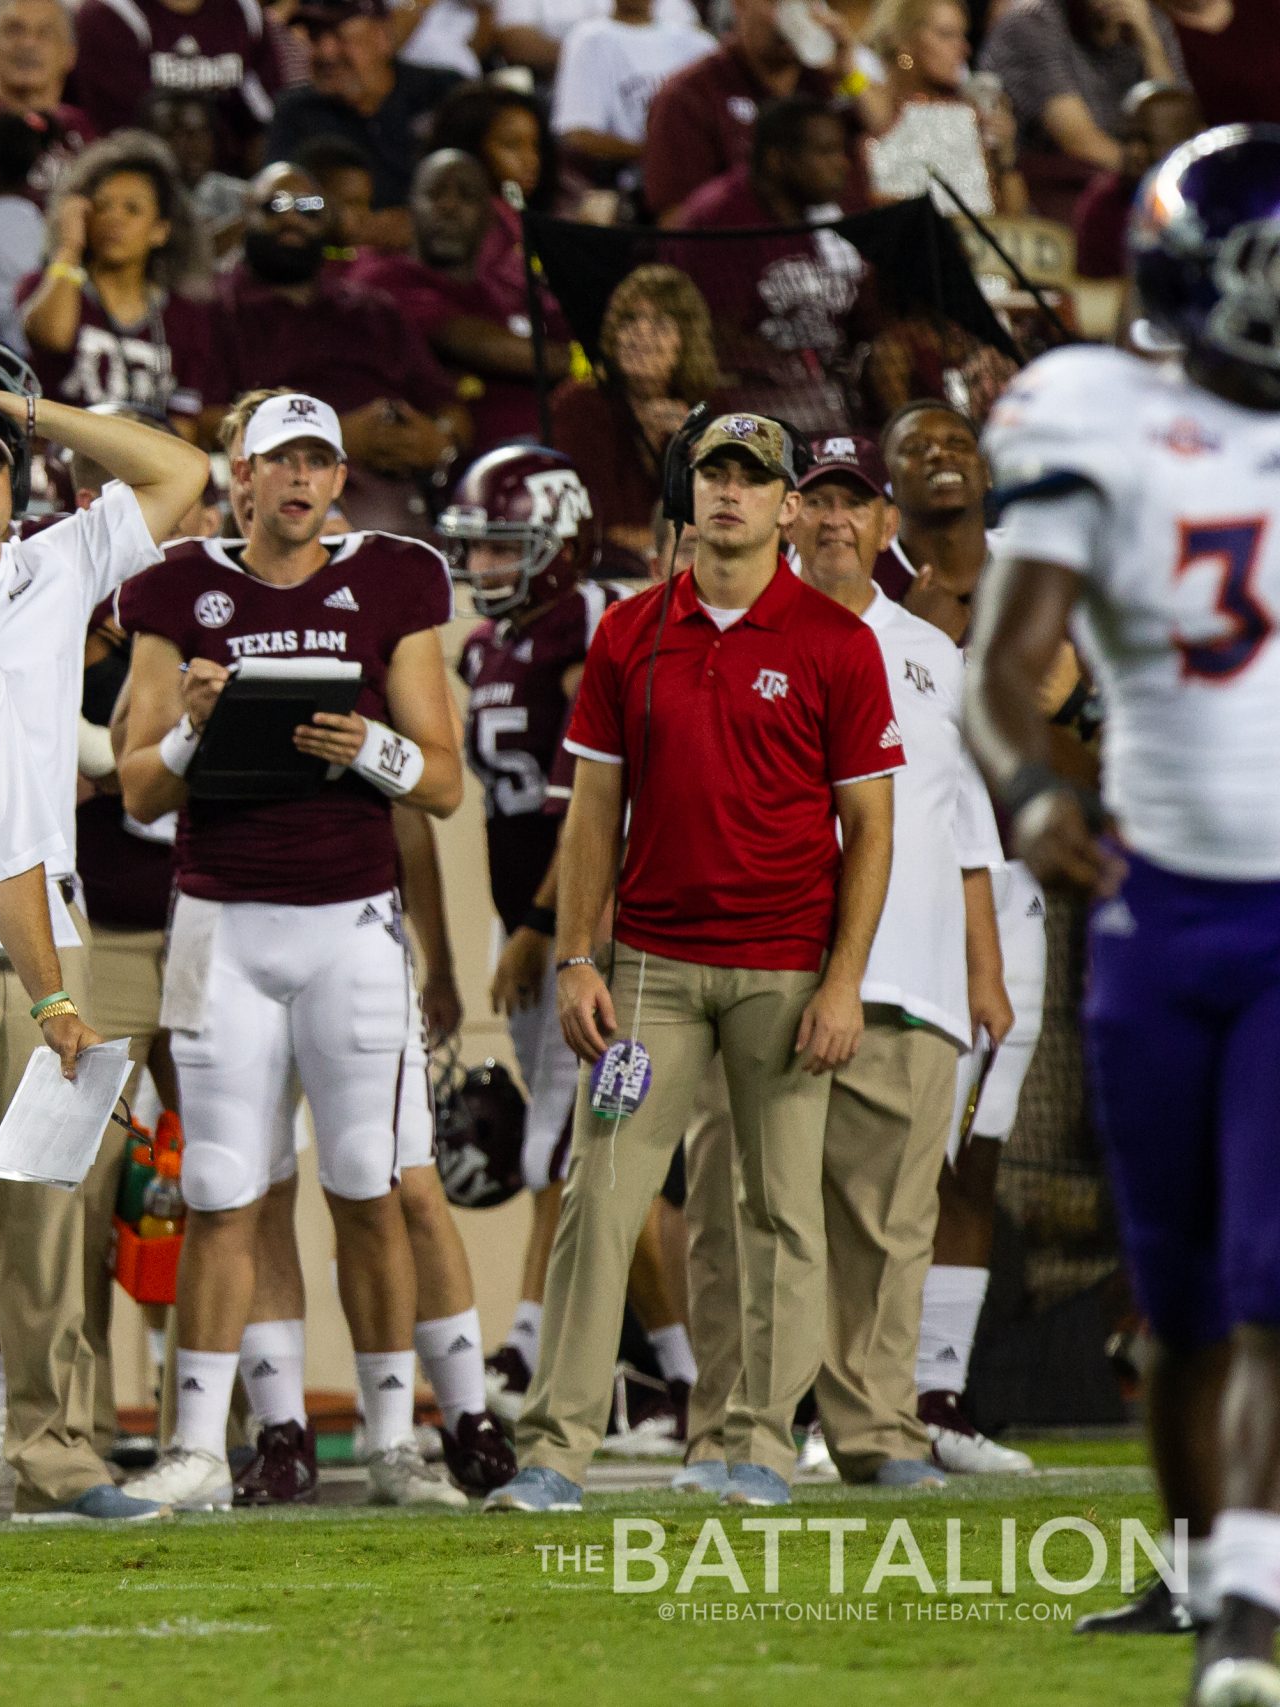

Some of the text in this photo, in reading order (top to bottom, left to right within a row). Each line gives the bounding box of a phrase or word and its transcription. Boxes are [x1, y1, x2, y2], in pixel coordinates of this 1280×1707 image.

[226, 629, 347, 657] TEXAS A&M
[1174, 514, 1272, 682] 3
